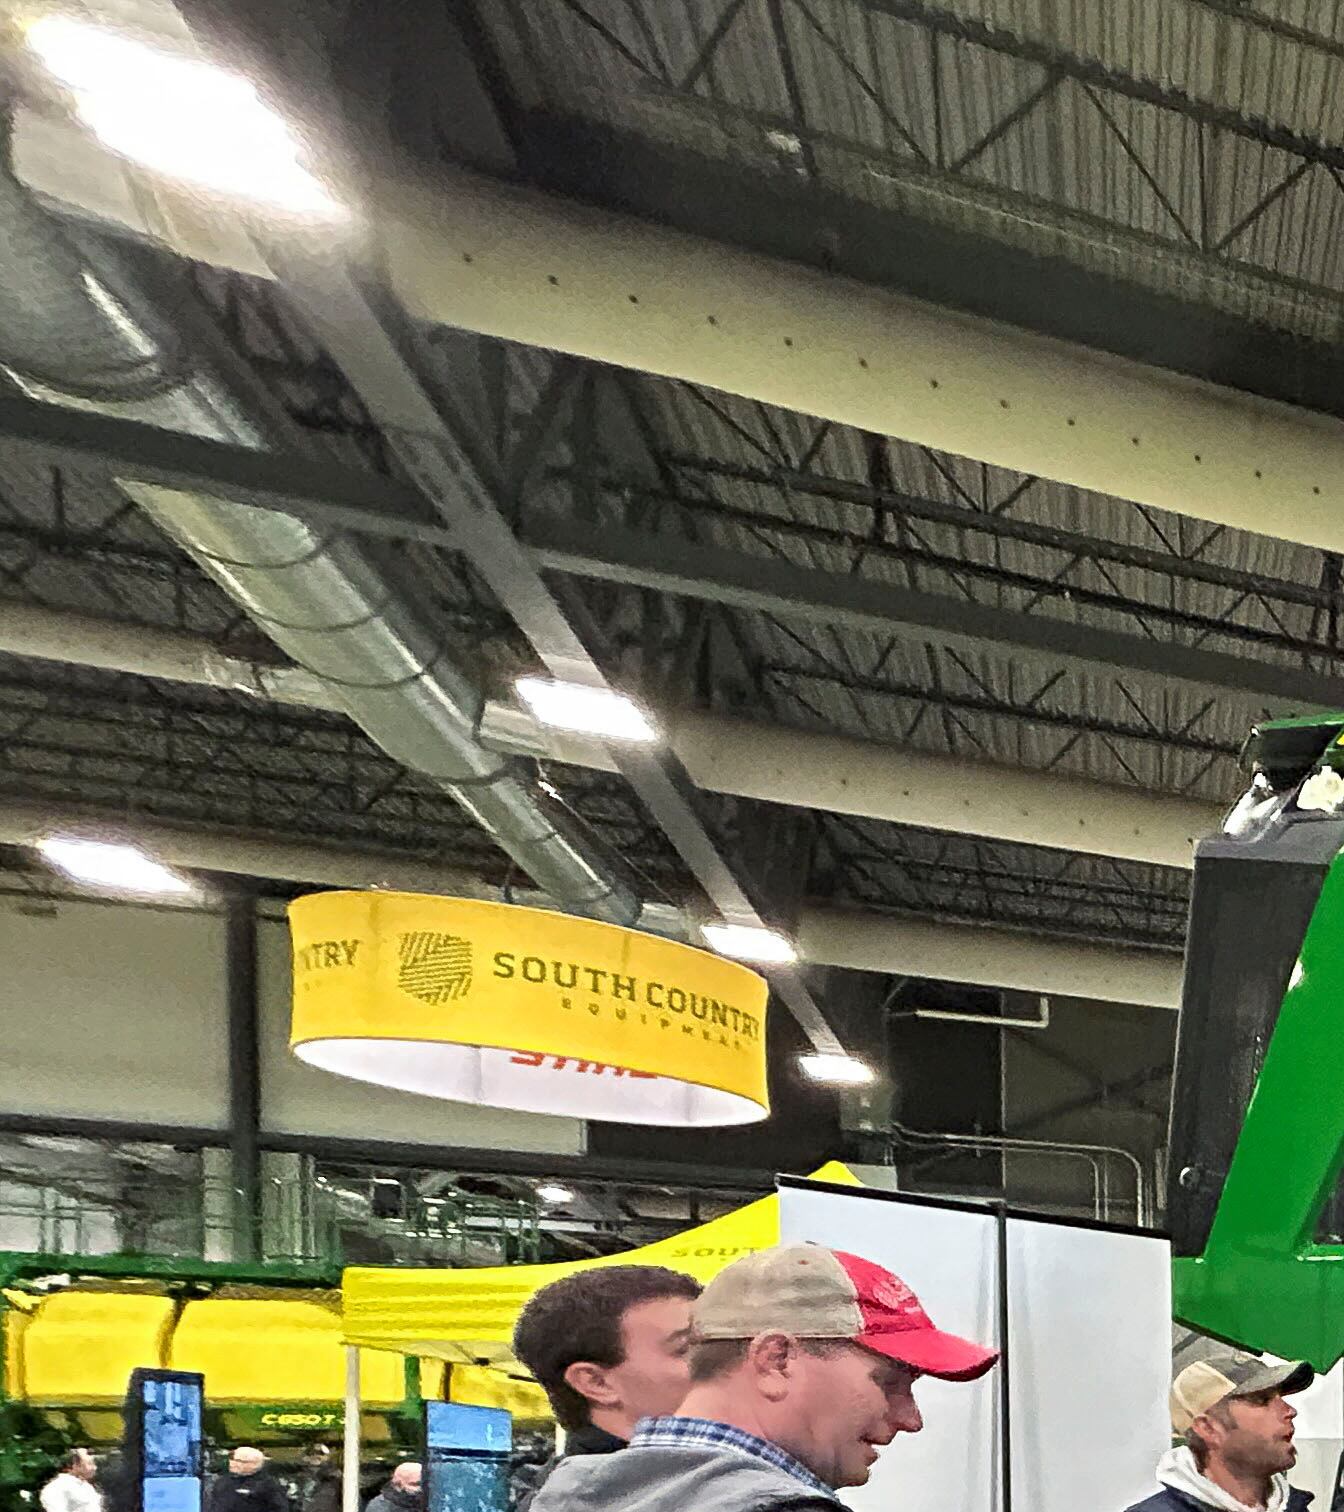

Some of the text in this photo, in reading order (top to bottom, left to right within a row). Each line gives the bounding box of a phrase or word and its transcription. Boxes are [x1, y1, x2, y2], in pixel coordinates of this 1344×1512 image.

[493, 951, 761, 1042] SOUTH COUNTRY
[669, 1246, 761, 1259] SOUT
